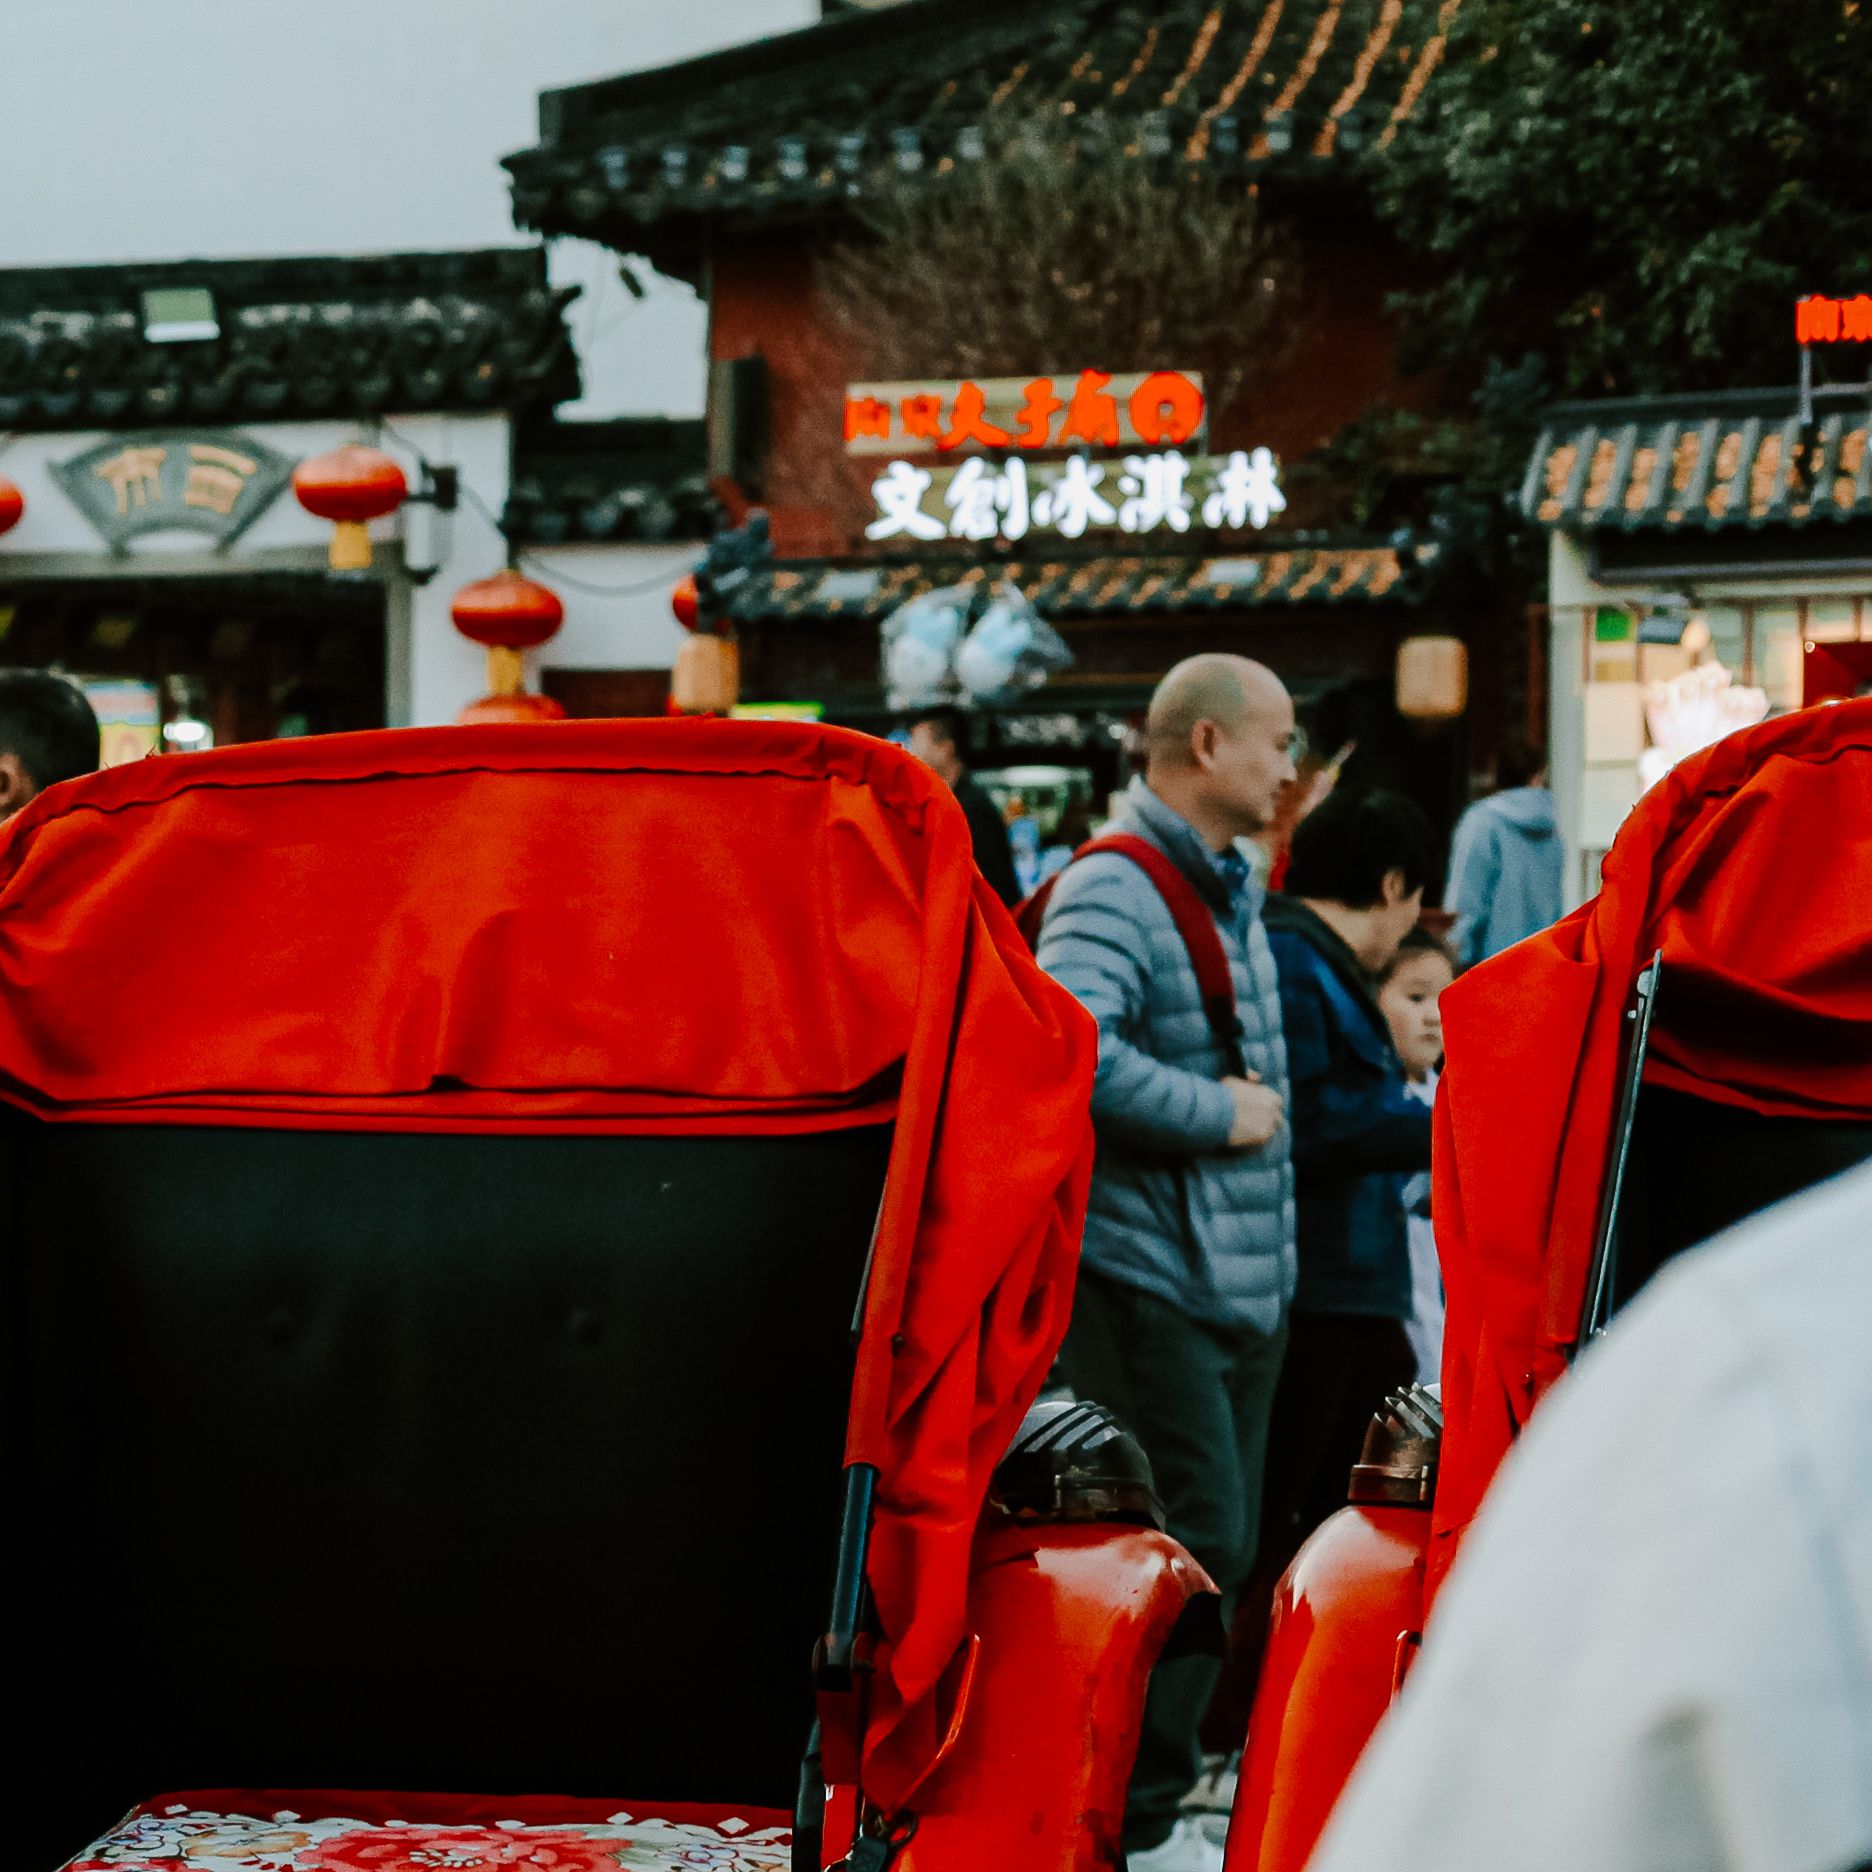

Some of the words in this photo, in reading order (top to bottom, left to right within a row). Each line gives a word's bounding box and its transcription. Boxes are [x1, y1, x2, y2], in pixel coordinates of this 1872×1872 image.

[864, 446, 1287, 542] 文創冰淇淋
